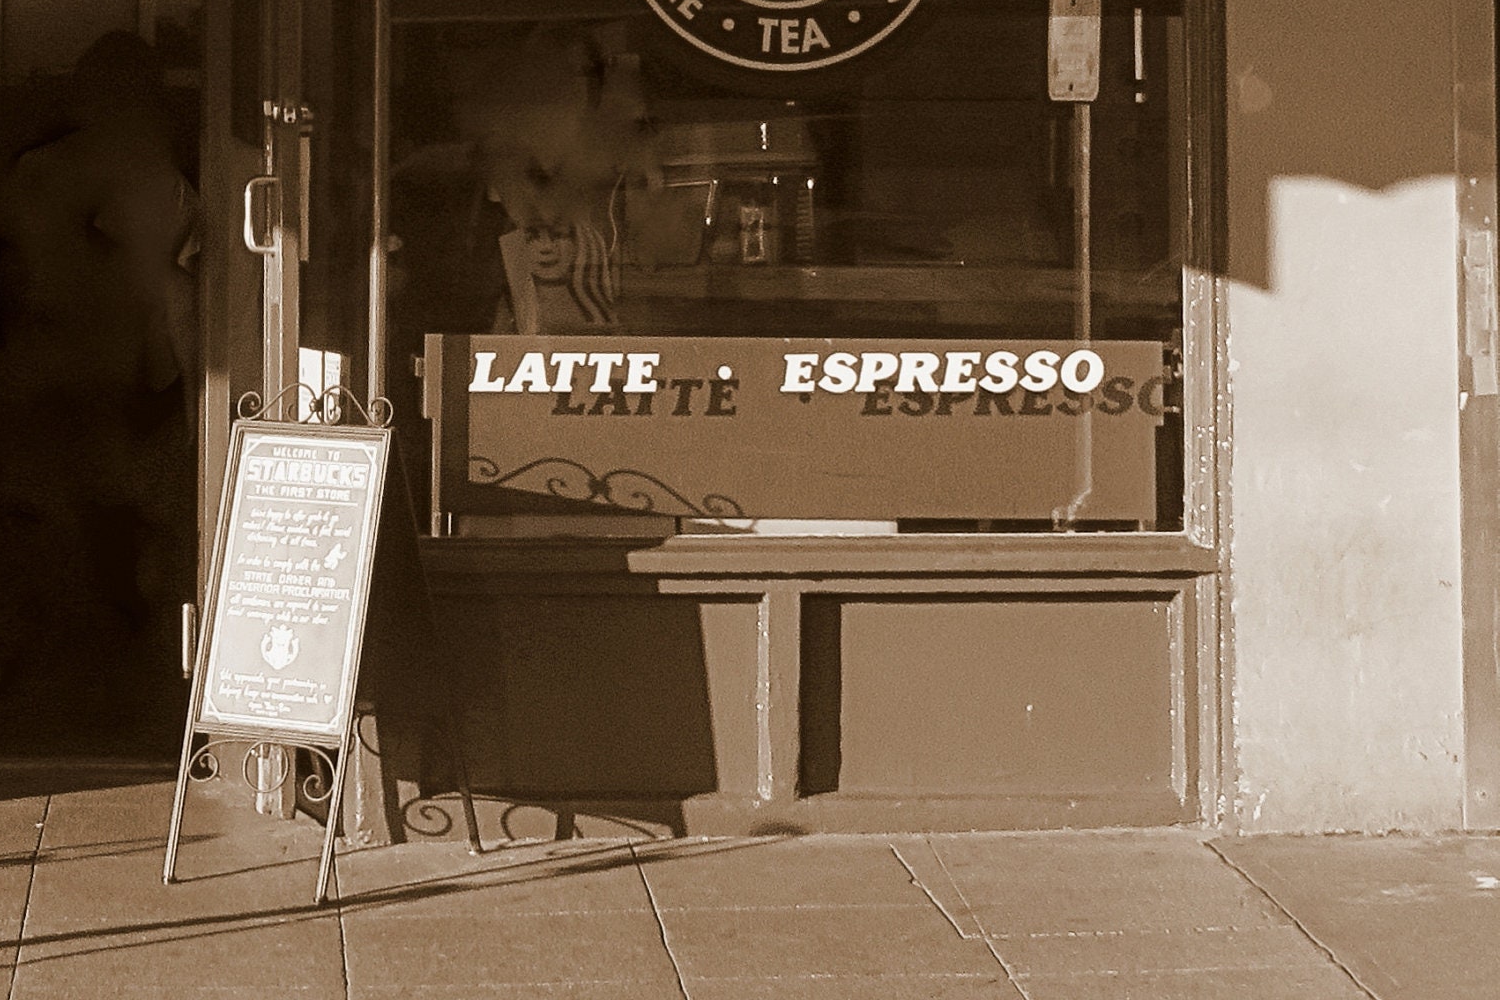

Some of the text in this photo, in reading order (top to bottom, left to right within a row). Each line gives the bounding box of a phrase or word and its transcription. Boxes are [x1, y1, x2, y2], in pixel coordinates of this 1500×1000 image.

[757, 17, 831, 55] TEA
[468, 350, 1105, 393] LATTE ESPRESSO
[247, 459, 368, 489] STARBUCKS
[255, 484, 275, 496] THE
[279, 486, 313, 499] FIRST
